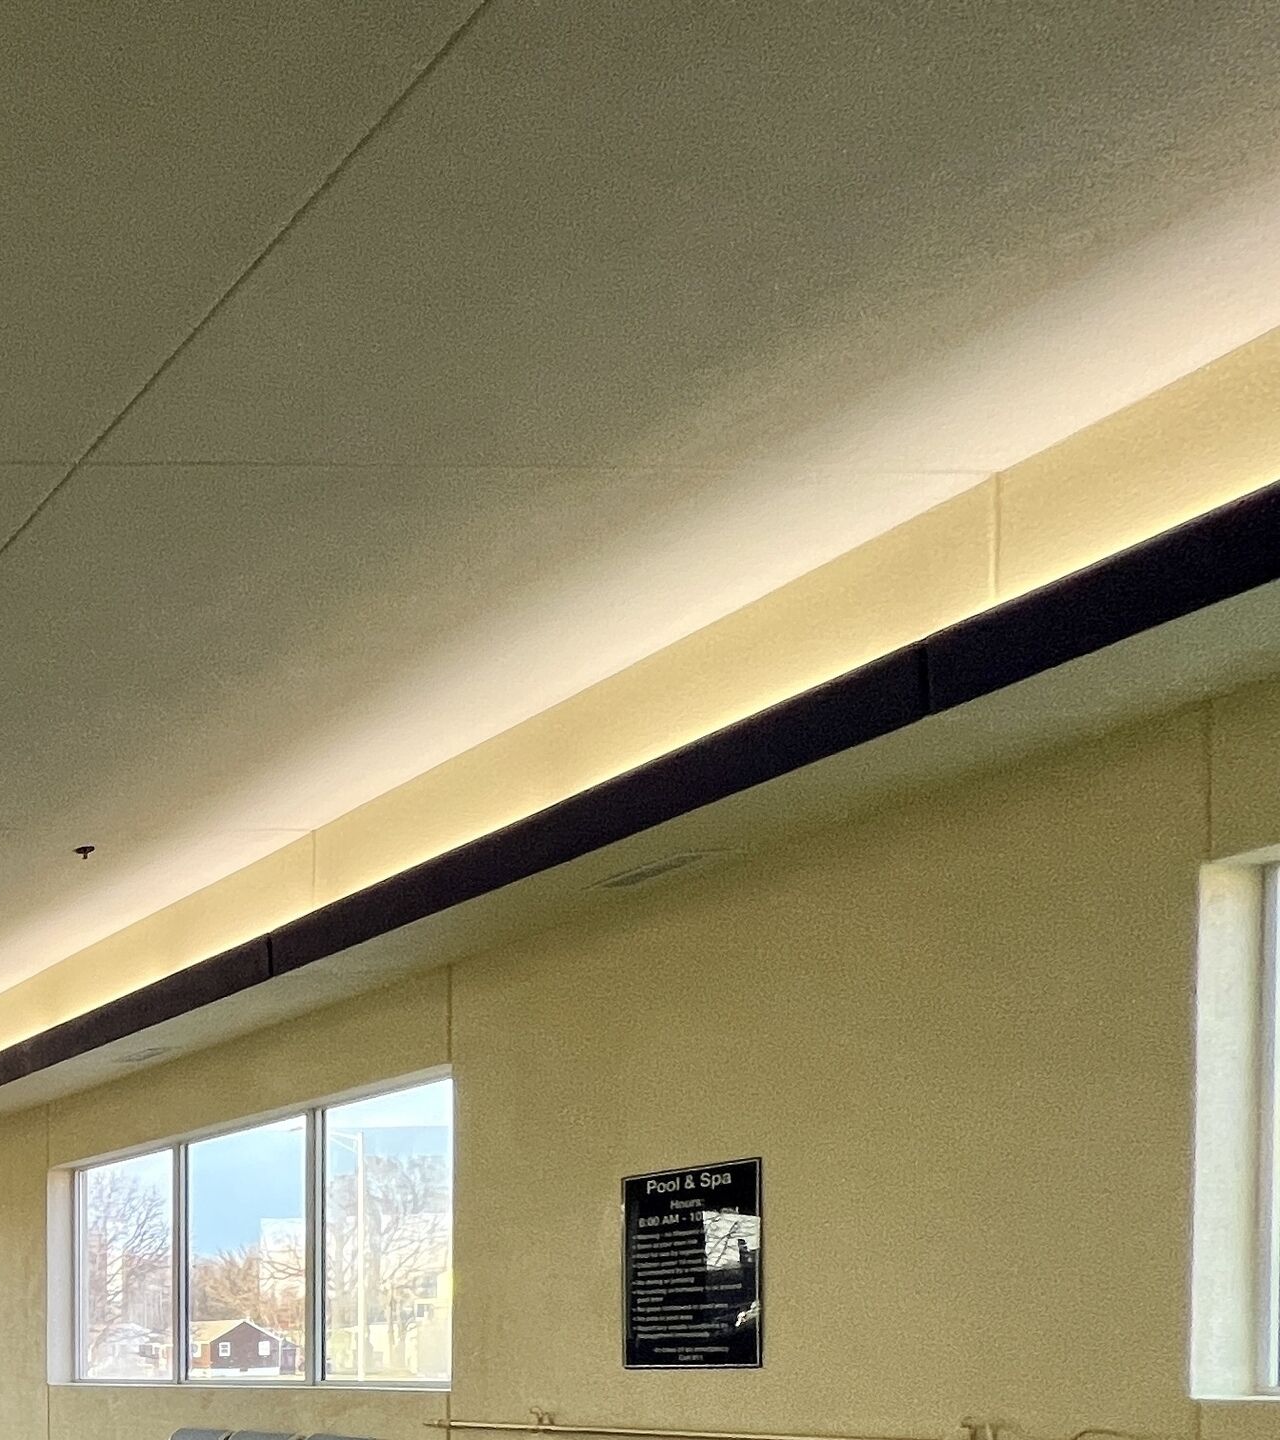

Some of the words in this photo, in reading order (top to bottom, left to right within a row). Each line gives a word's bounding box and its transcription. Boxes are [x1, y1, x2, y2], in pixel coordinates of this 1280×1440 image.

[646, 1177, 680, 1195] Pool
[684, 1174, 696, 1190] &
[700, 1172, 732, 1190] Spa
[662, 1214, 680, 1225] AM
